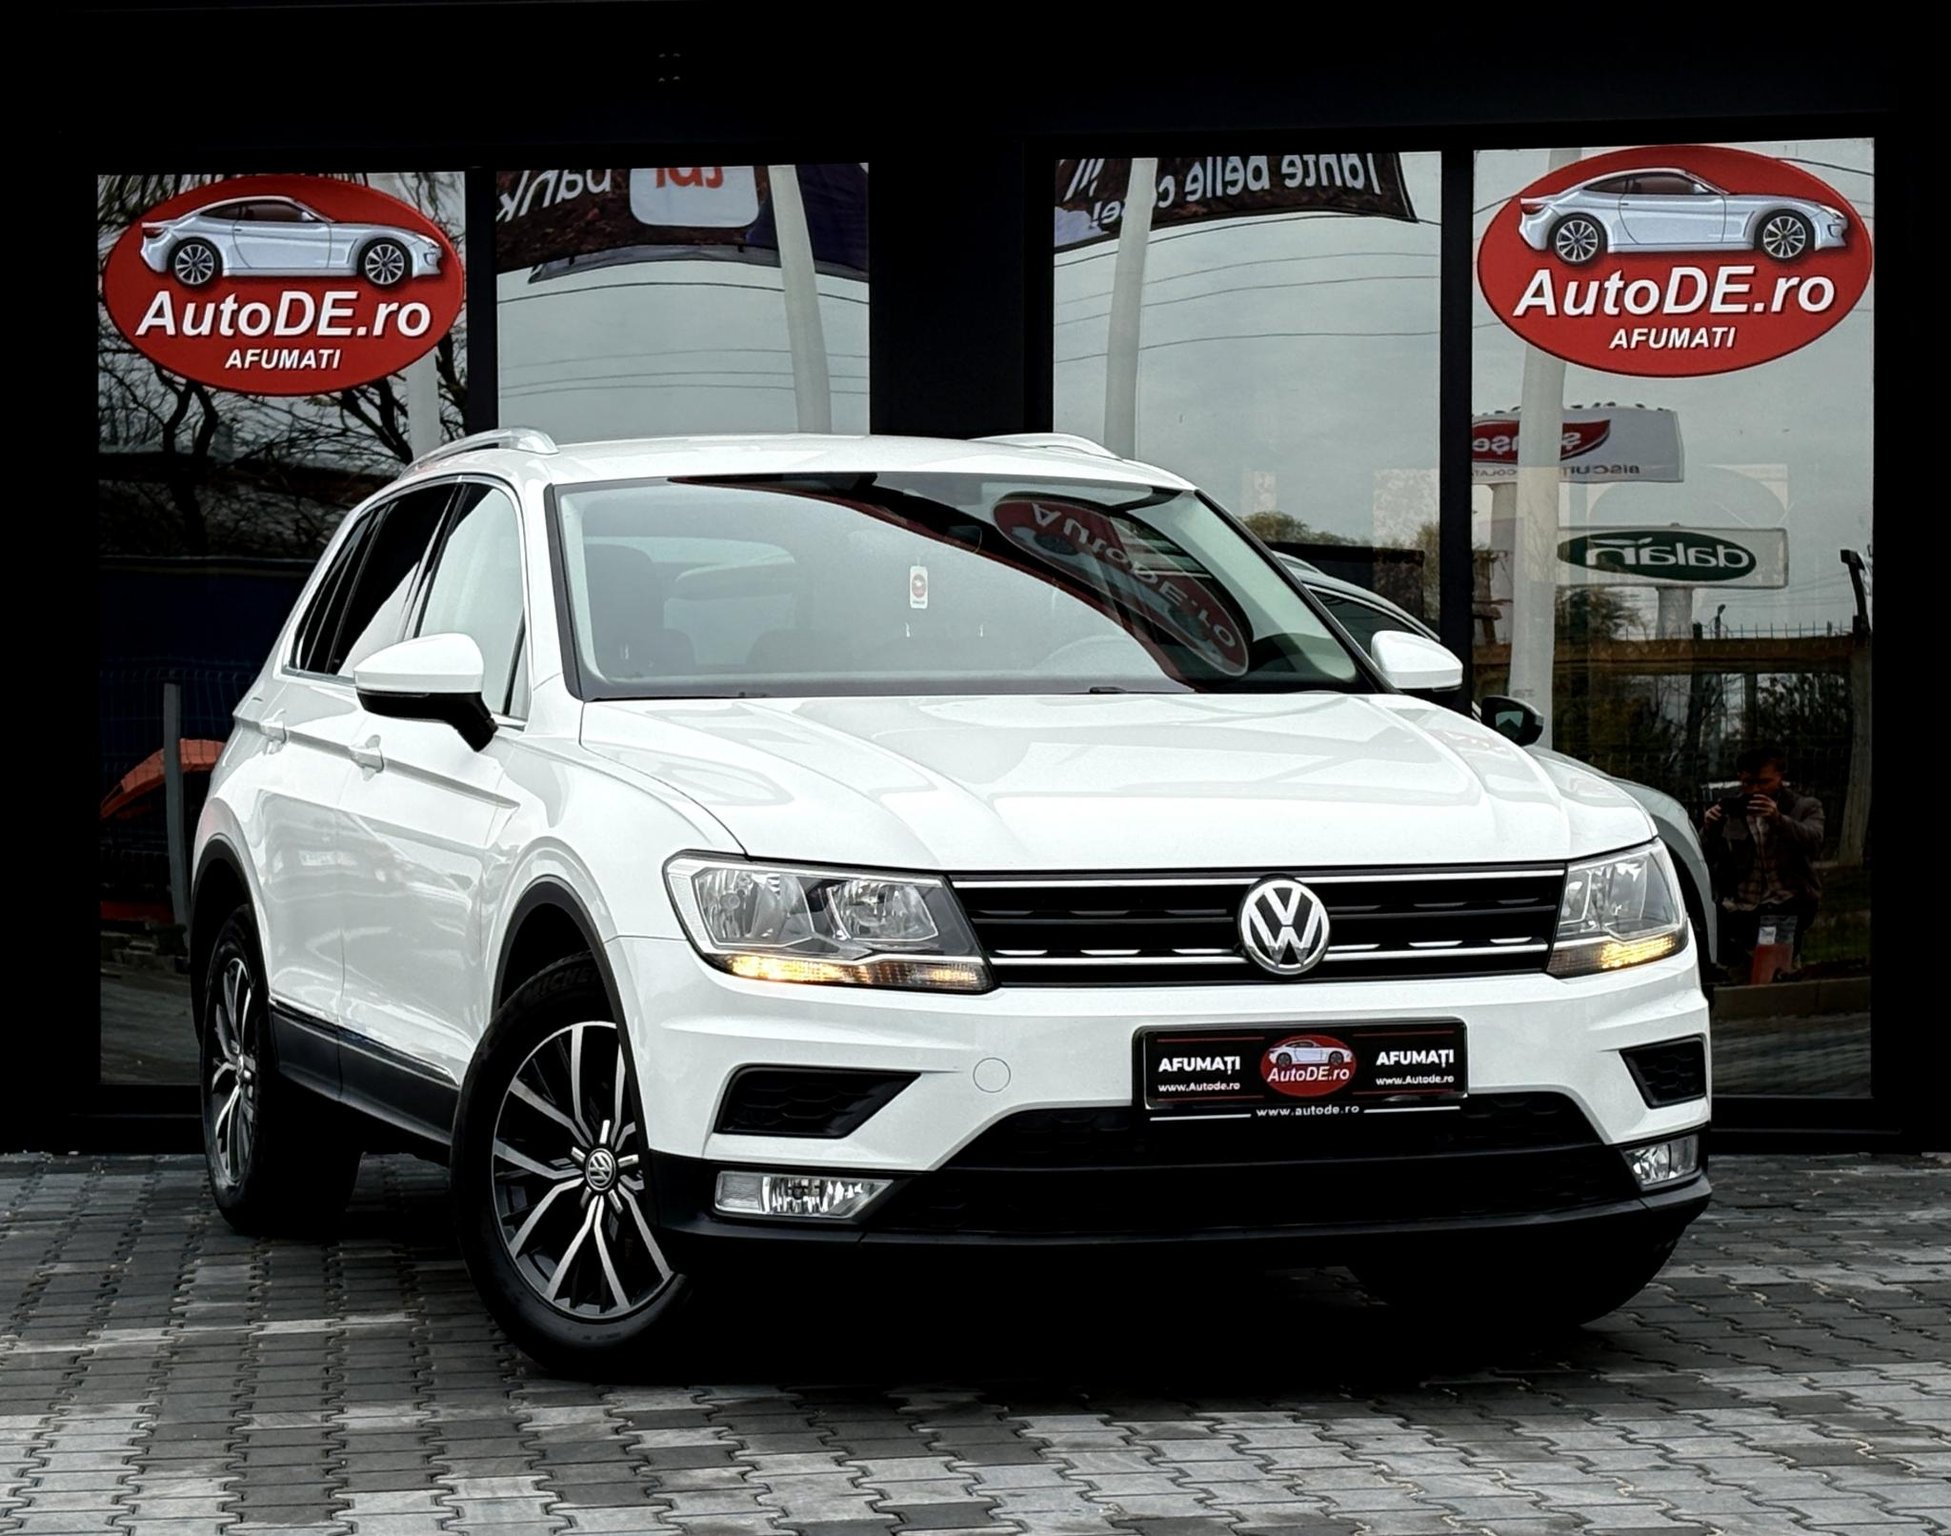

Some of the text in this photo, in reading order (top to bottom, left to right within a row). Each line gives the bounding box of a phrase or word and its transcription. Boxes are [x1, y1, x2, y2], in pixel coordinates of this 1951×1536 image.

[1513, 265, 1834, 316] AutoDE.ro
[136, 290, 431, 336] AutoDE.ro
[1609, 327, 1736, 349] AFUMATI
[224, 348, 341, 369] AFUMATI
[1267, 1066, 1350, 1082] AutoDE.ro
[1375, 1074, 1455, 1086] www.Autode.ro
[1158, 1081, 1241, 1092] www.Autode.ro
[1255, 1104, 1360, 1117] www.autode.ro
